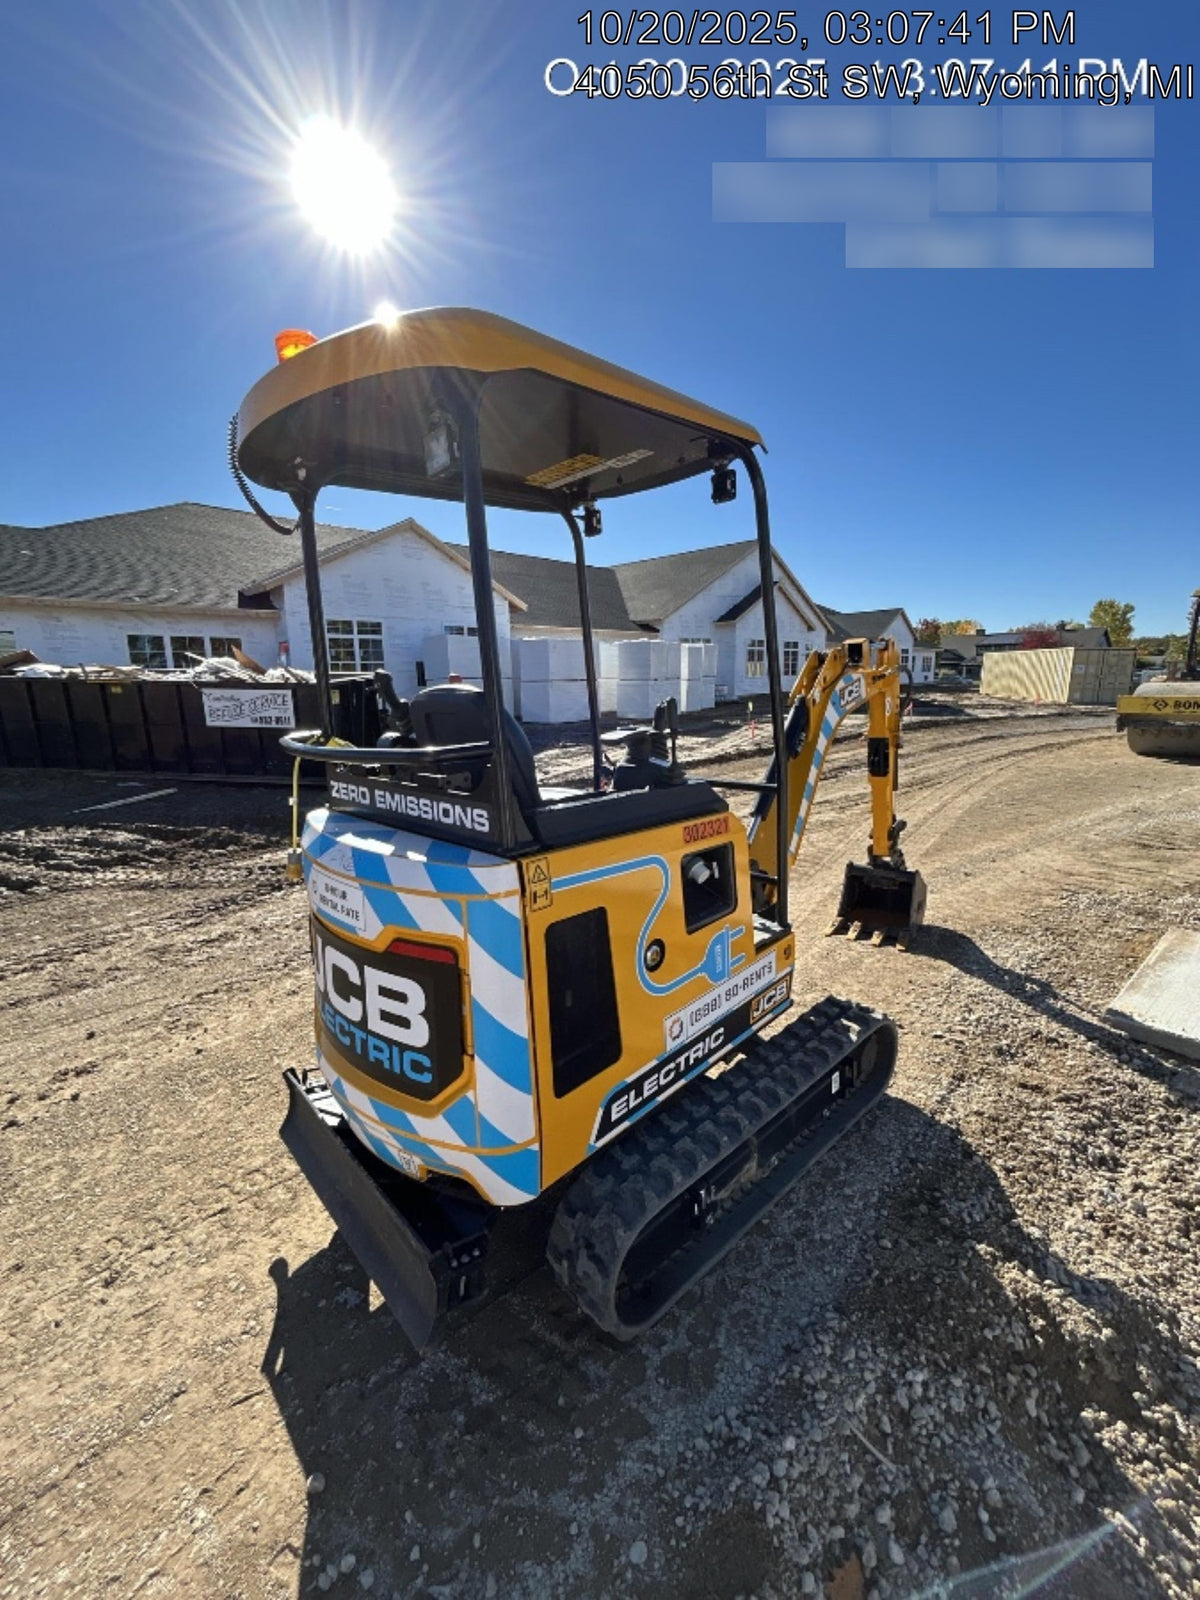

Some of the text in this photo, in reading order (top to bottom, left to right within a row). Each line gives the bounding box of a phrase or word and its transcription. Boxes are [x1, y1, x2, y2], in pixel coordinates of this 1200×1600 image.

[840, 680, 862, 707] JCB
[330, 780, 490, 833] ZERO EMISSIONS
[683, 816, 729, 843] 302321
[315, 933, 430, 1048] JCB
[753, 981, 787, 1017] JCB
[320, 1001, 433, 1084] LECTRIC
[610, 1027, 725, 1123] ELECTRIC
